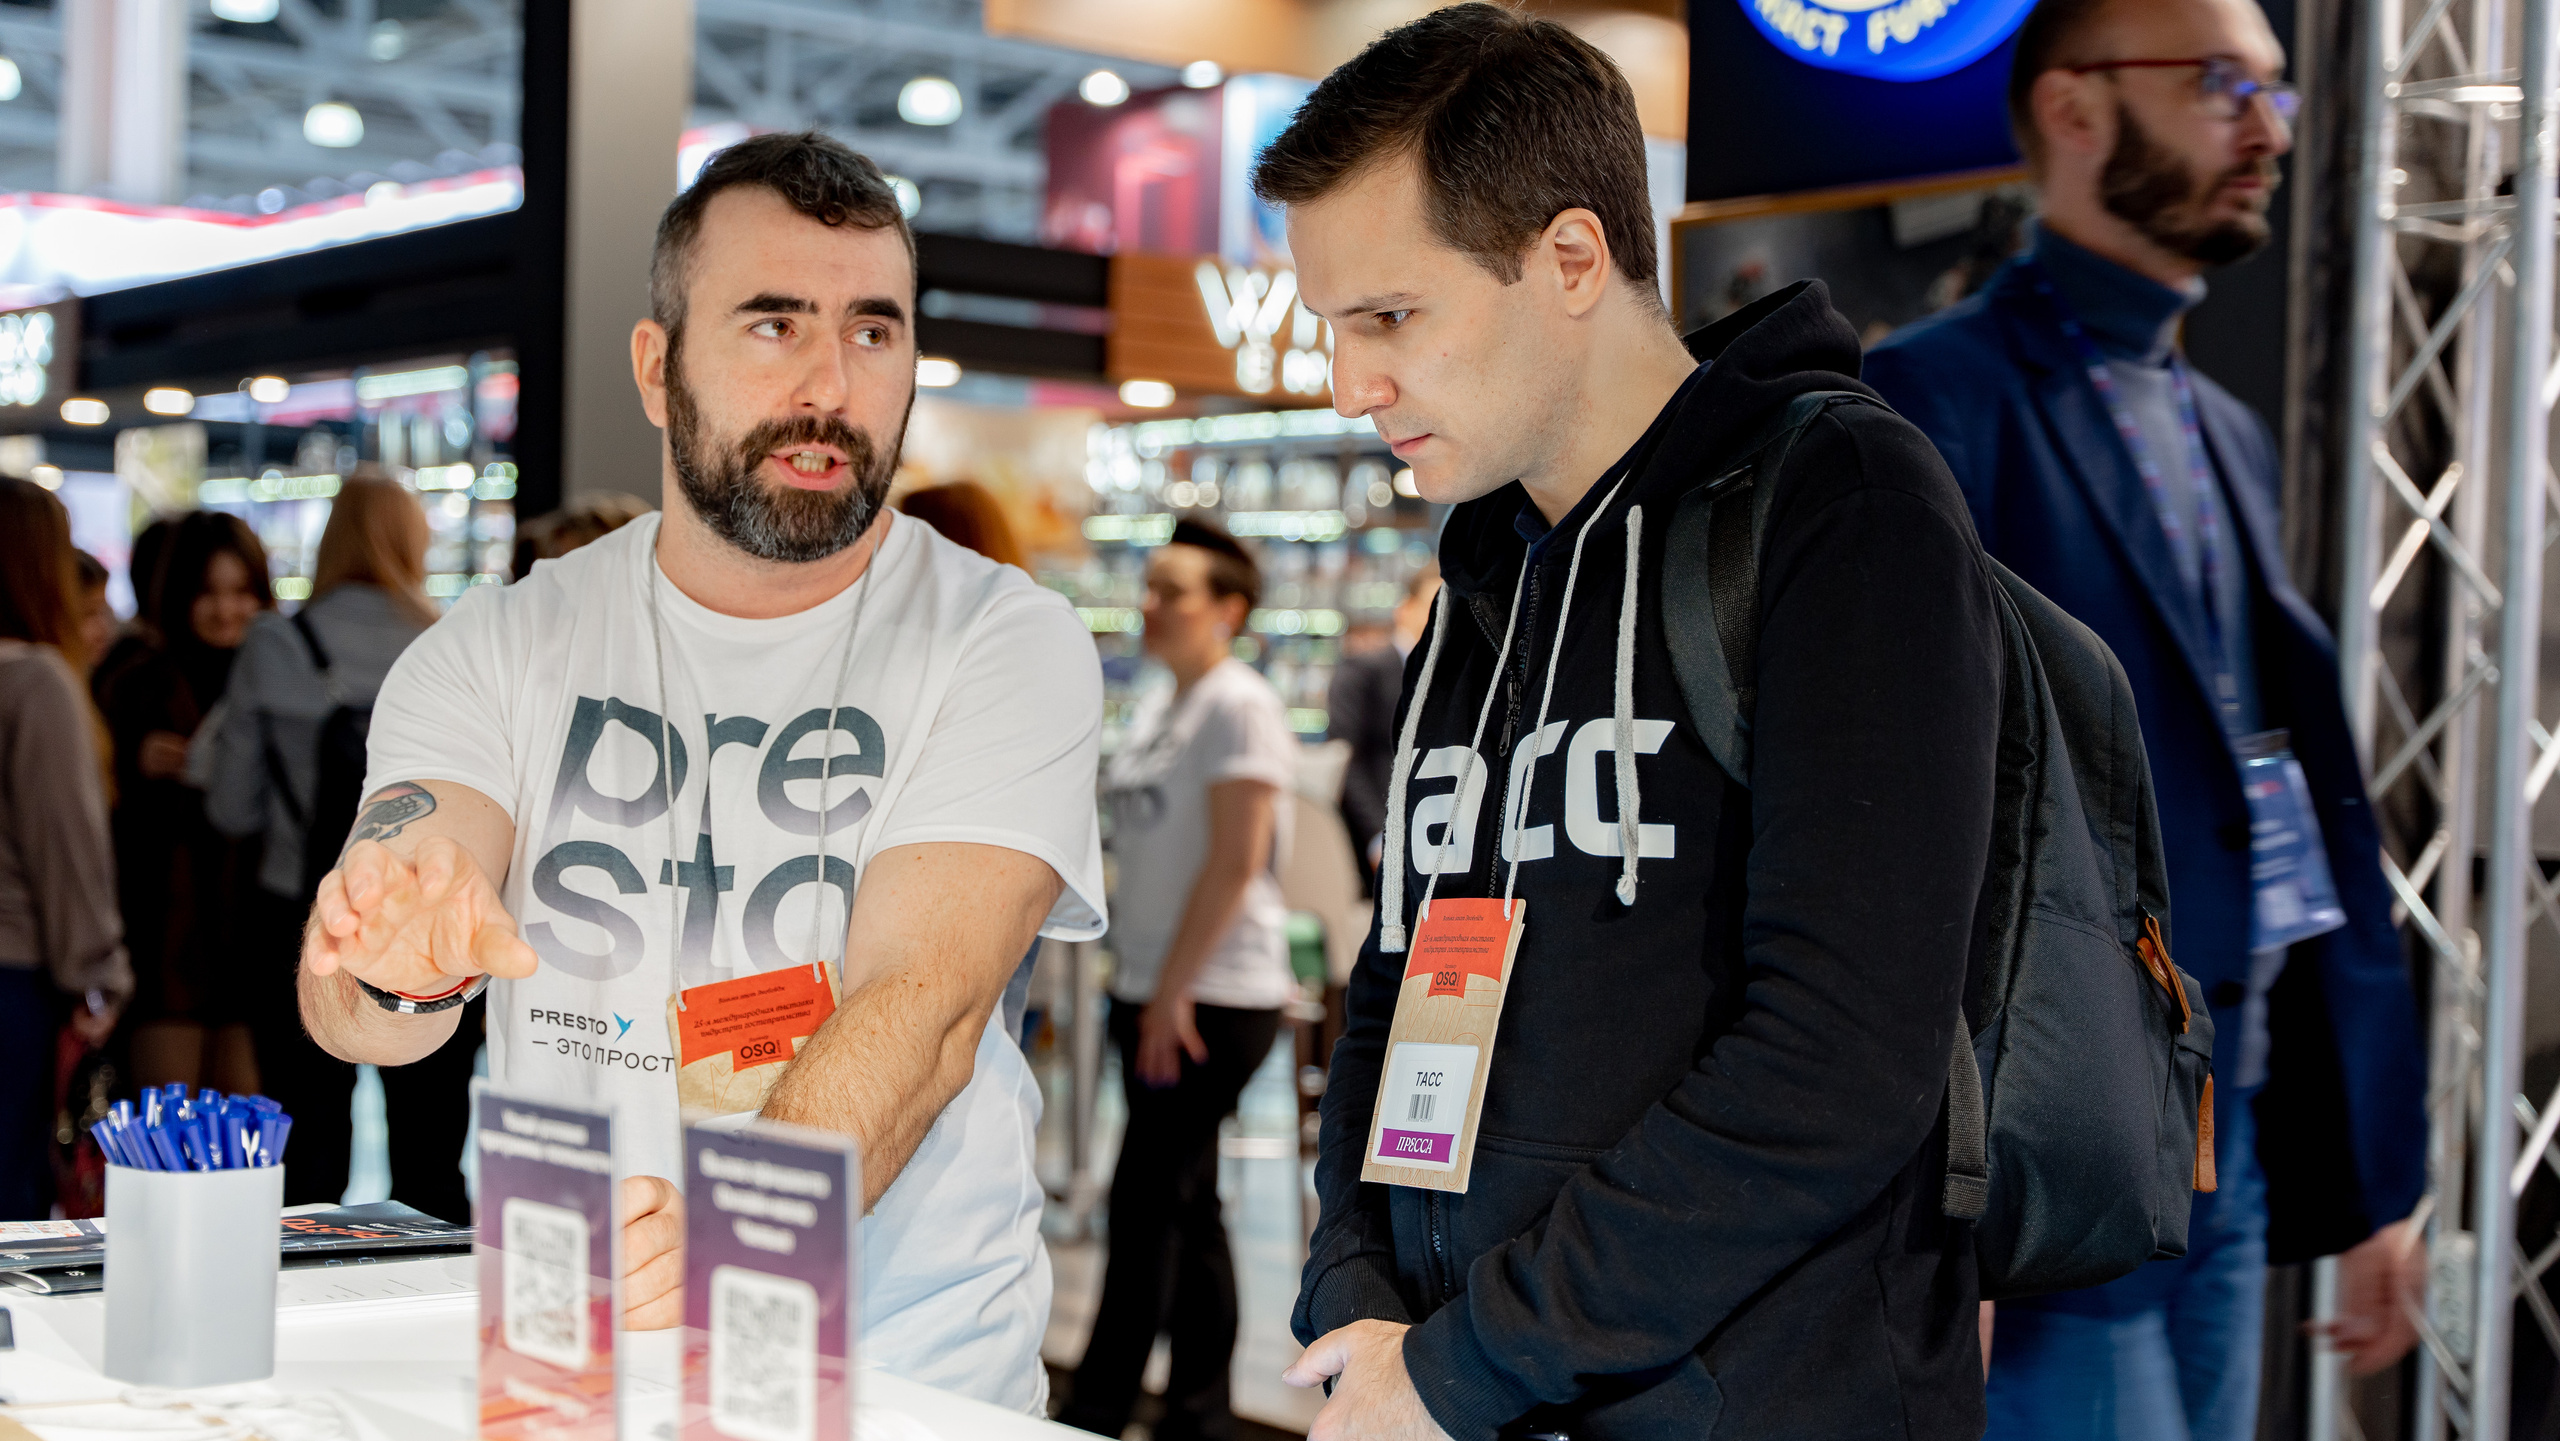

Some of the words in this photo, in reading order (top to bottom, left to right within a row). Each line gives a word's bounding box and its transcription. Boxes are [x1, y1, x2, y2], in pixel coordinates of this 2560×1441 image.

[540, 696, 886, 846] pre
[1407, 717, 1676, 875] асс
[525, 833, 855, 983] sto
[1435, 971, 1457, 985] OSQ
[530, 1008, 608, 1035] PRESTO
[700, 1023, 743, 1038] индустрии
[744, 1010, 812, 1030] гостеприимства
[712, 1006, 775, 1025] международная
[775, 999, 815, 1012] выставка
[556, 1038, 592, 1060] ЭТО
[740, 1041, 776, 1059] OSQ
[1415, 1071, 1444, 1087] ТАСС
[1395, 1136, 1434, 1154] ПРЕССА
